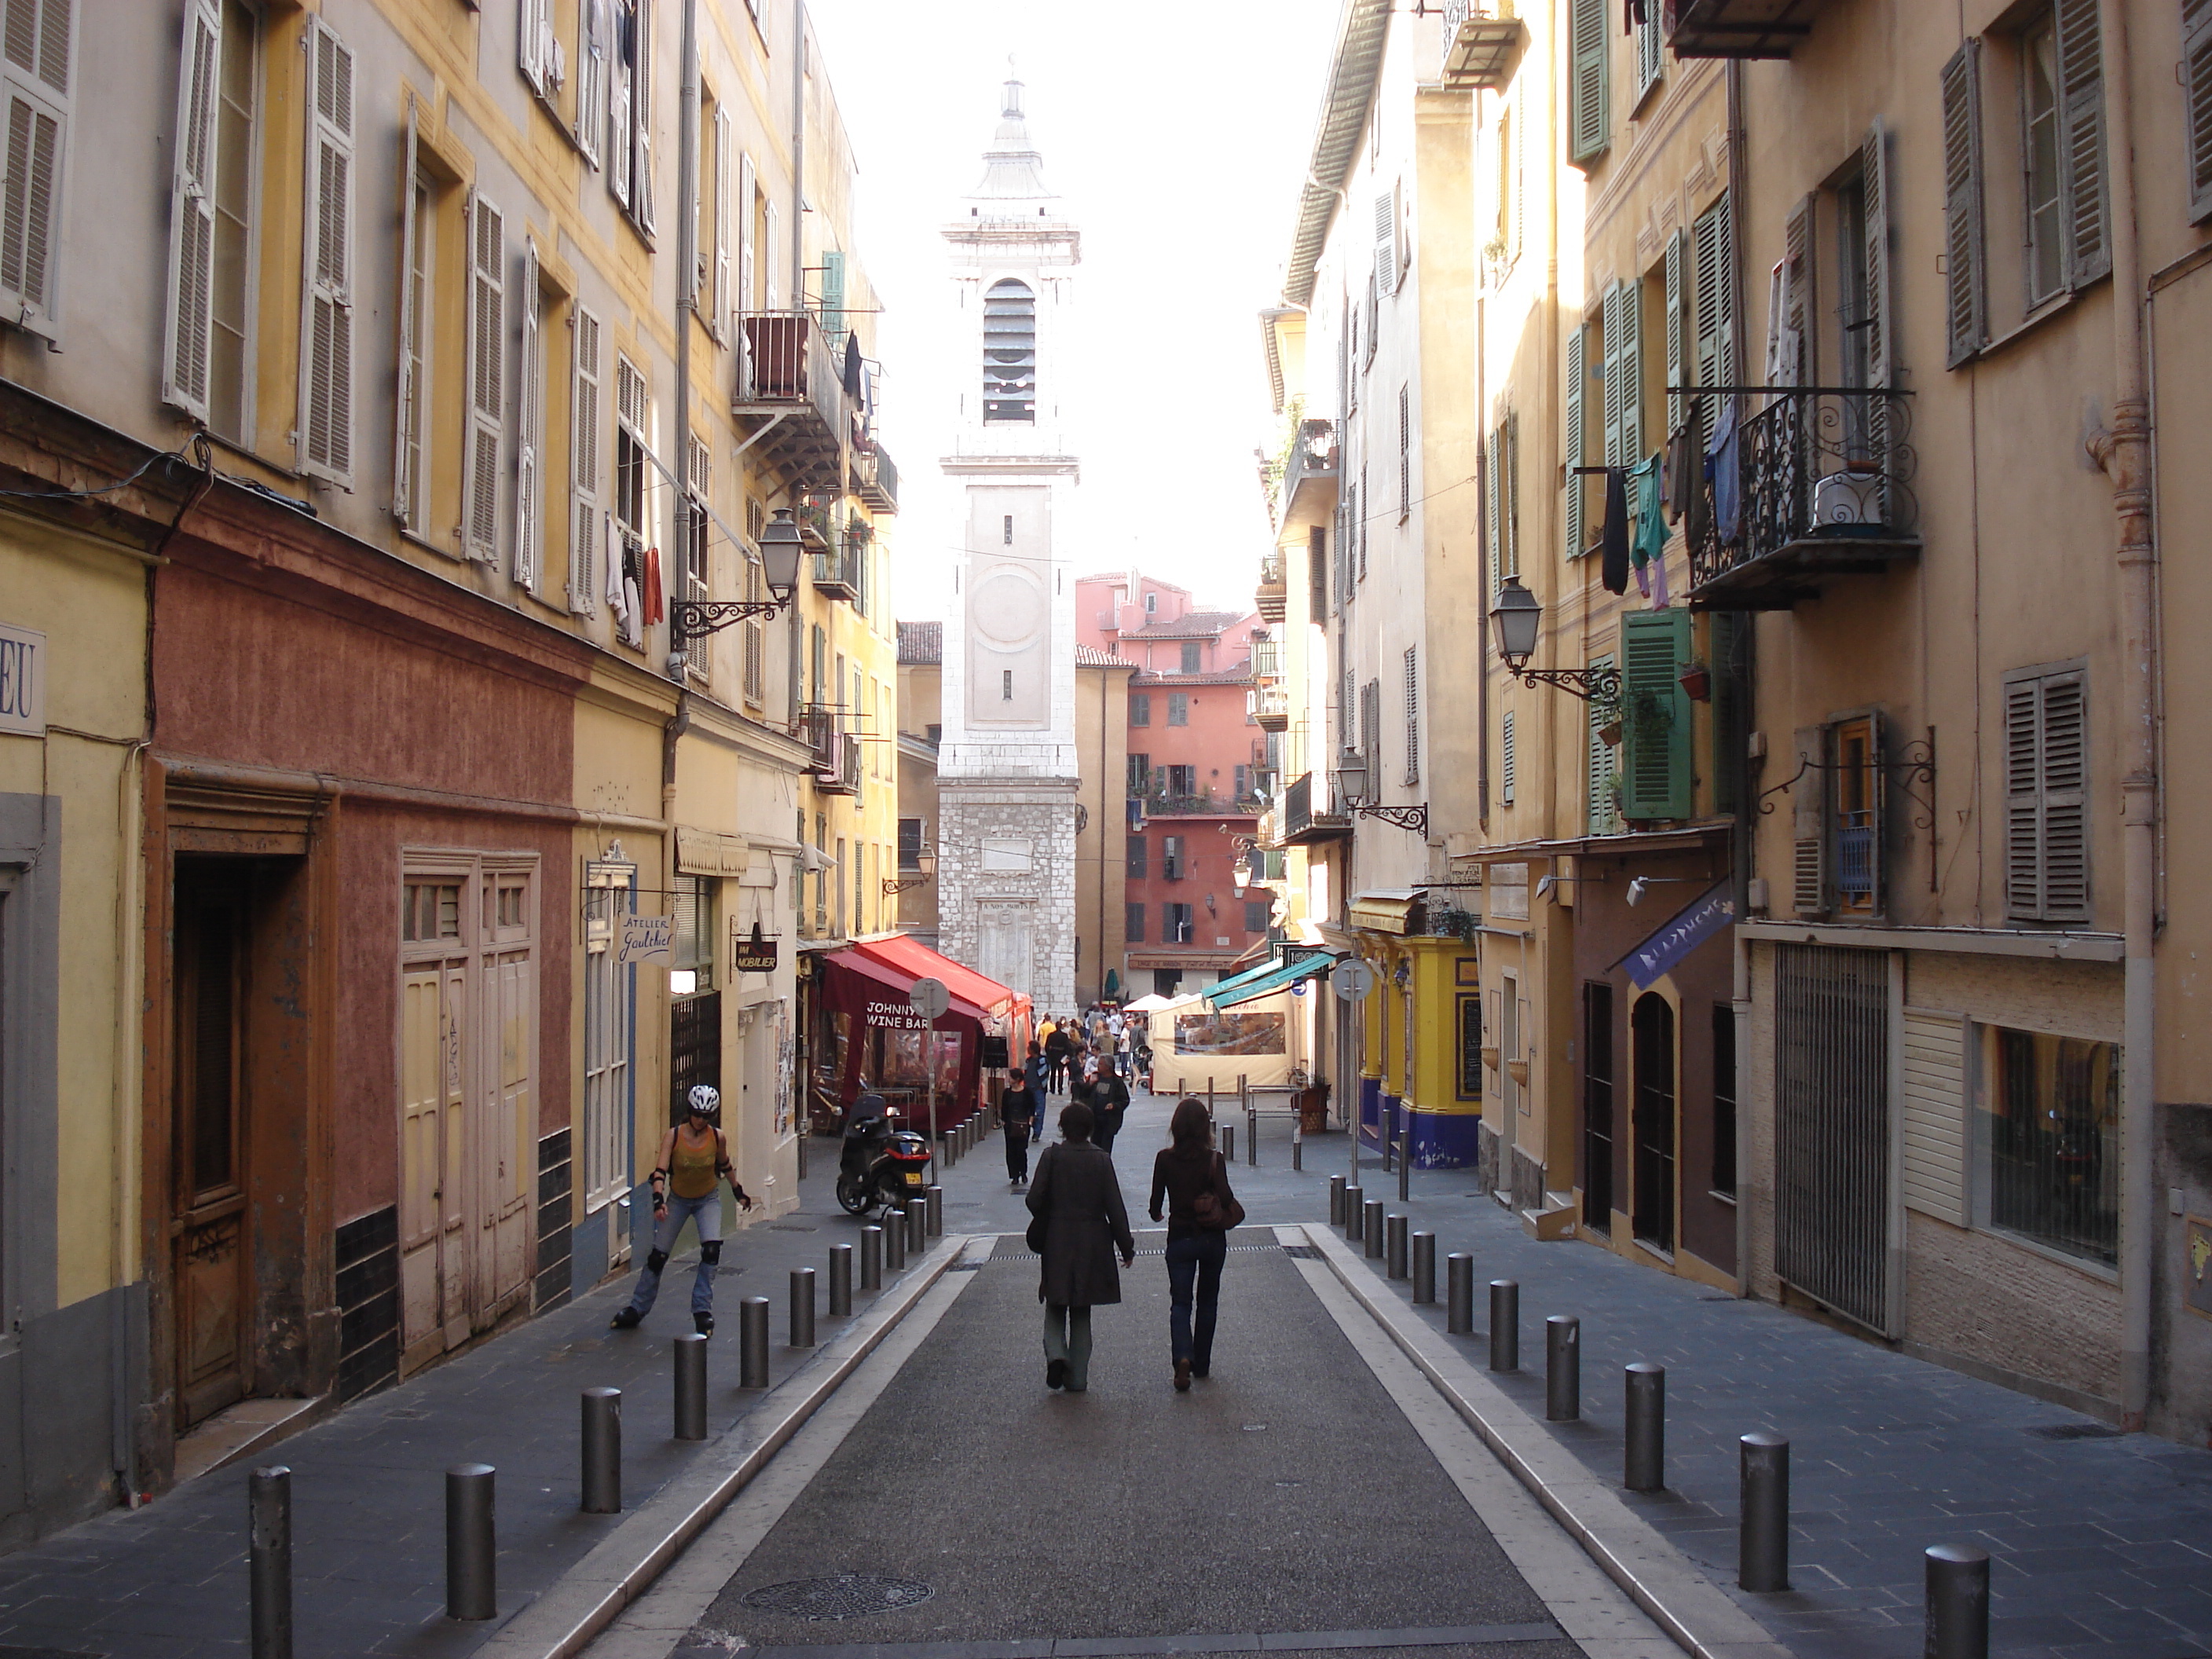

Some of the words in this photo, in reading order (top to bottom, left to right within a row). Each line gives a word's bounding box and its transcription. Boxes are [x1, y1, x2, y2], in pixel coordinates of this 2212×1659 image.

[623, 917, 668, 928] ATELIER
[619, 930, 675, 962] Gaulthier
[738, 957, 776, 968] MOBILIER
[866, 1014, 903, 1028] WINE
[906, 1019, 928, 1029] BAR
